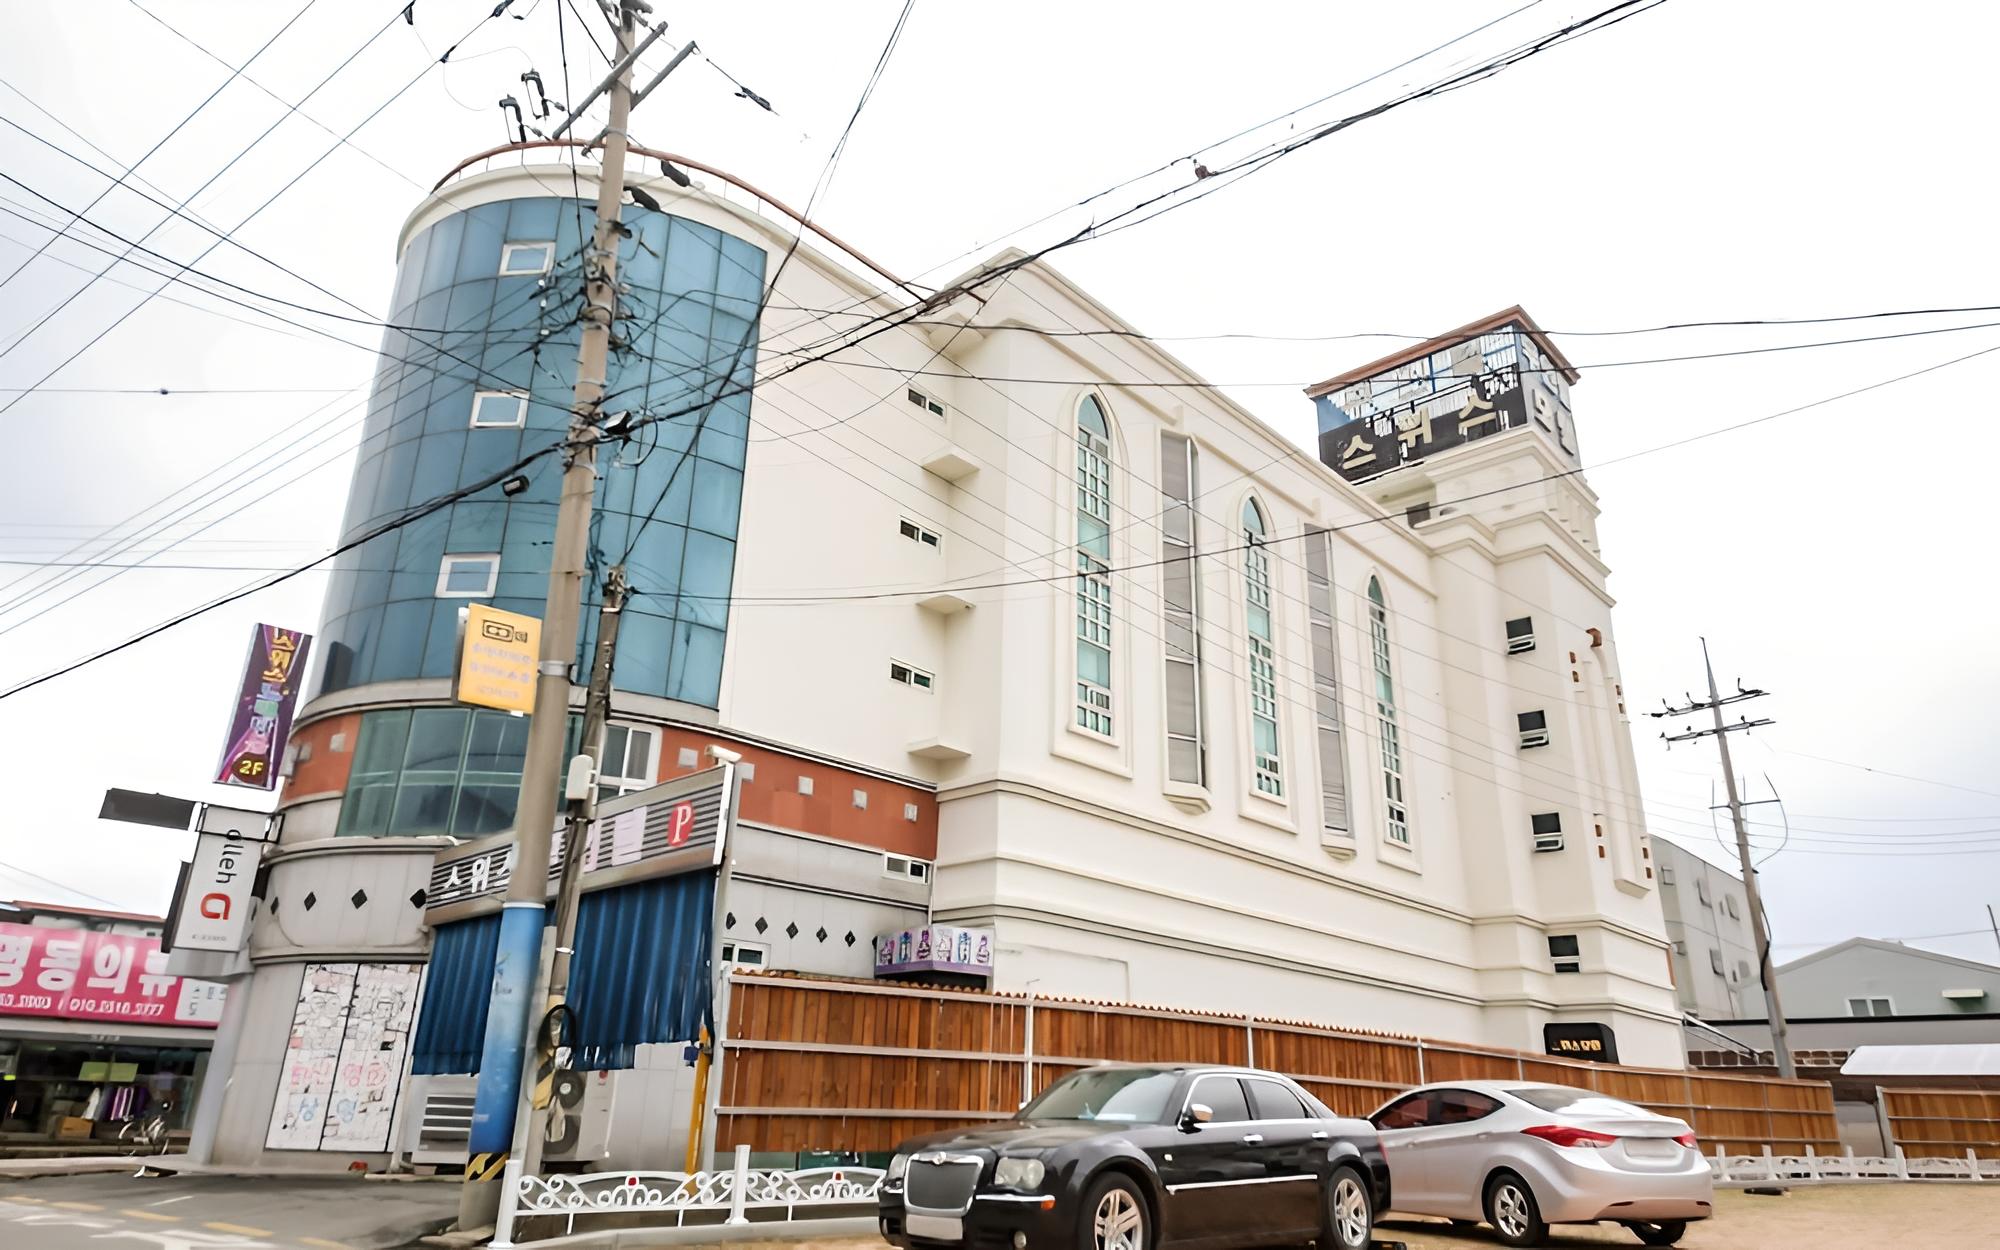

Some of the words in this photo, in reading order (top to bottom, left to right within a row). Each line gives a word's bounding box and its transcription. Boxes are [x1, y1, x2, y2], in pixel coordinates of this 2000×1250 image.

[239, 759, 264, 776] 2F
[671, 805, 692, 843] P
[216, 829, 244, 884] olleh
